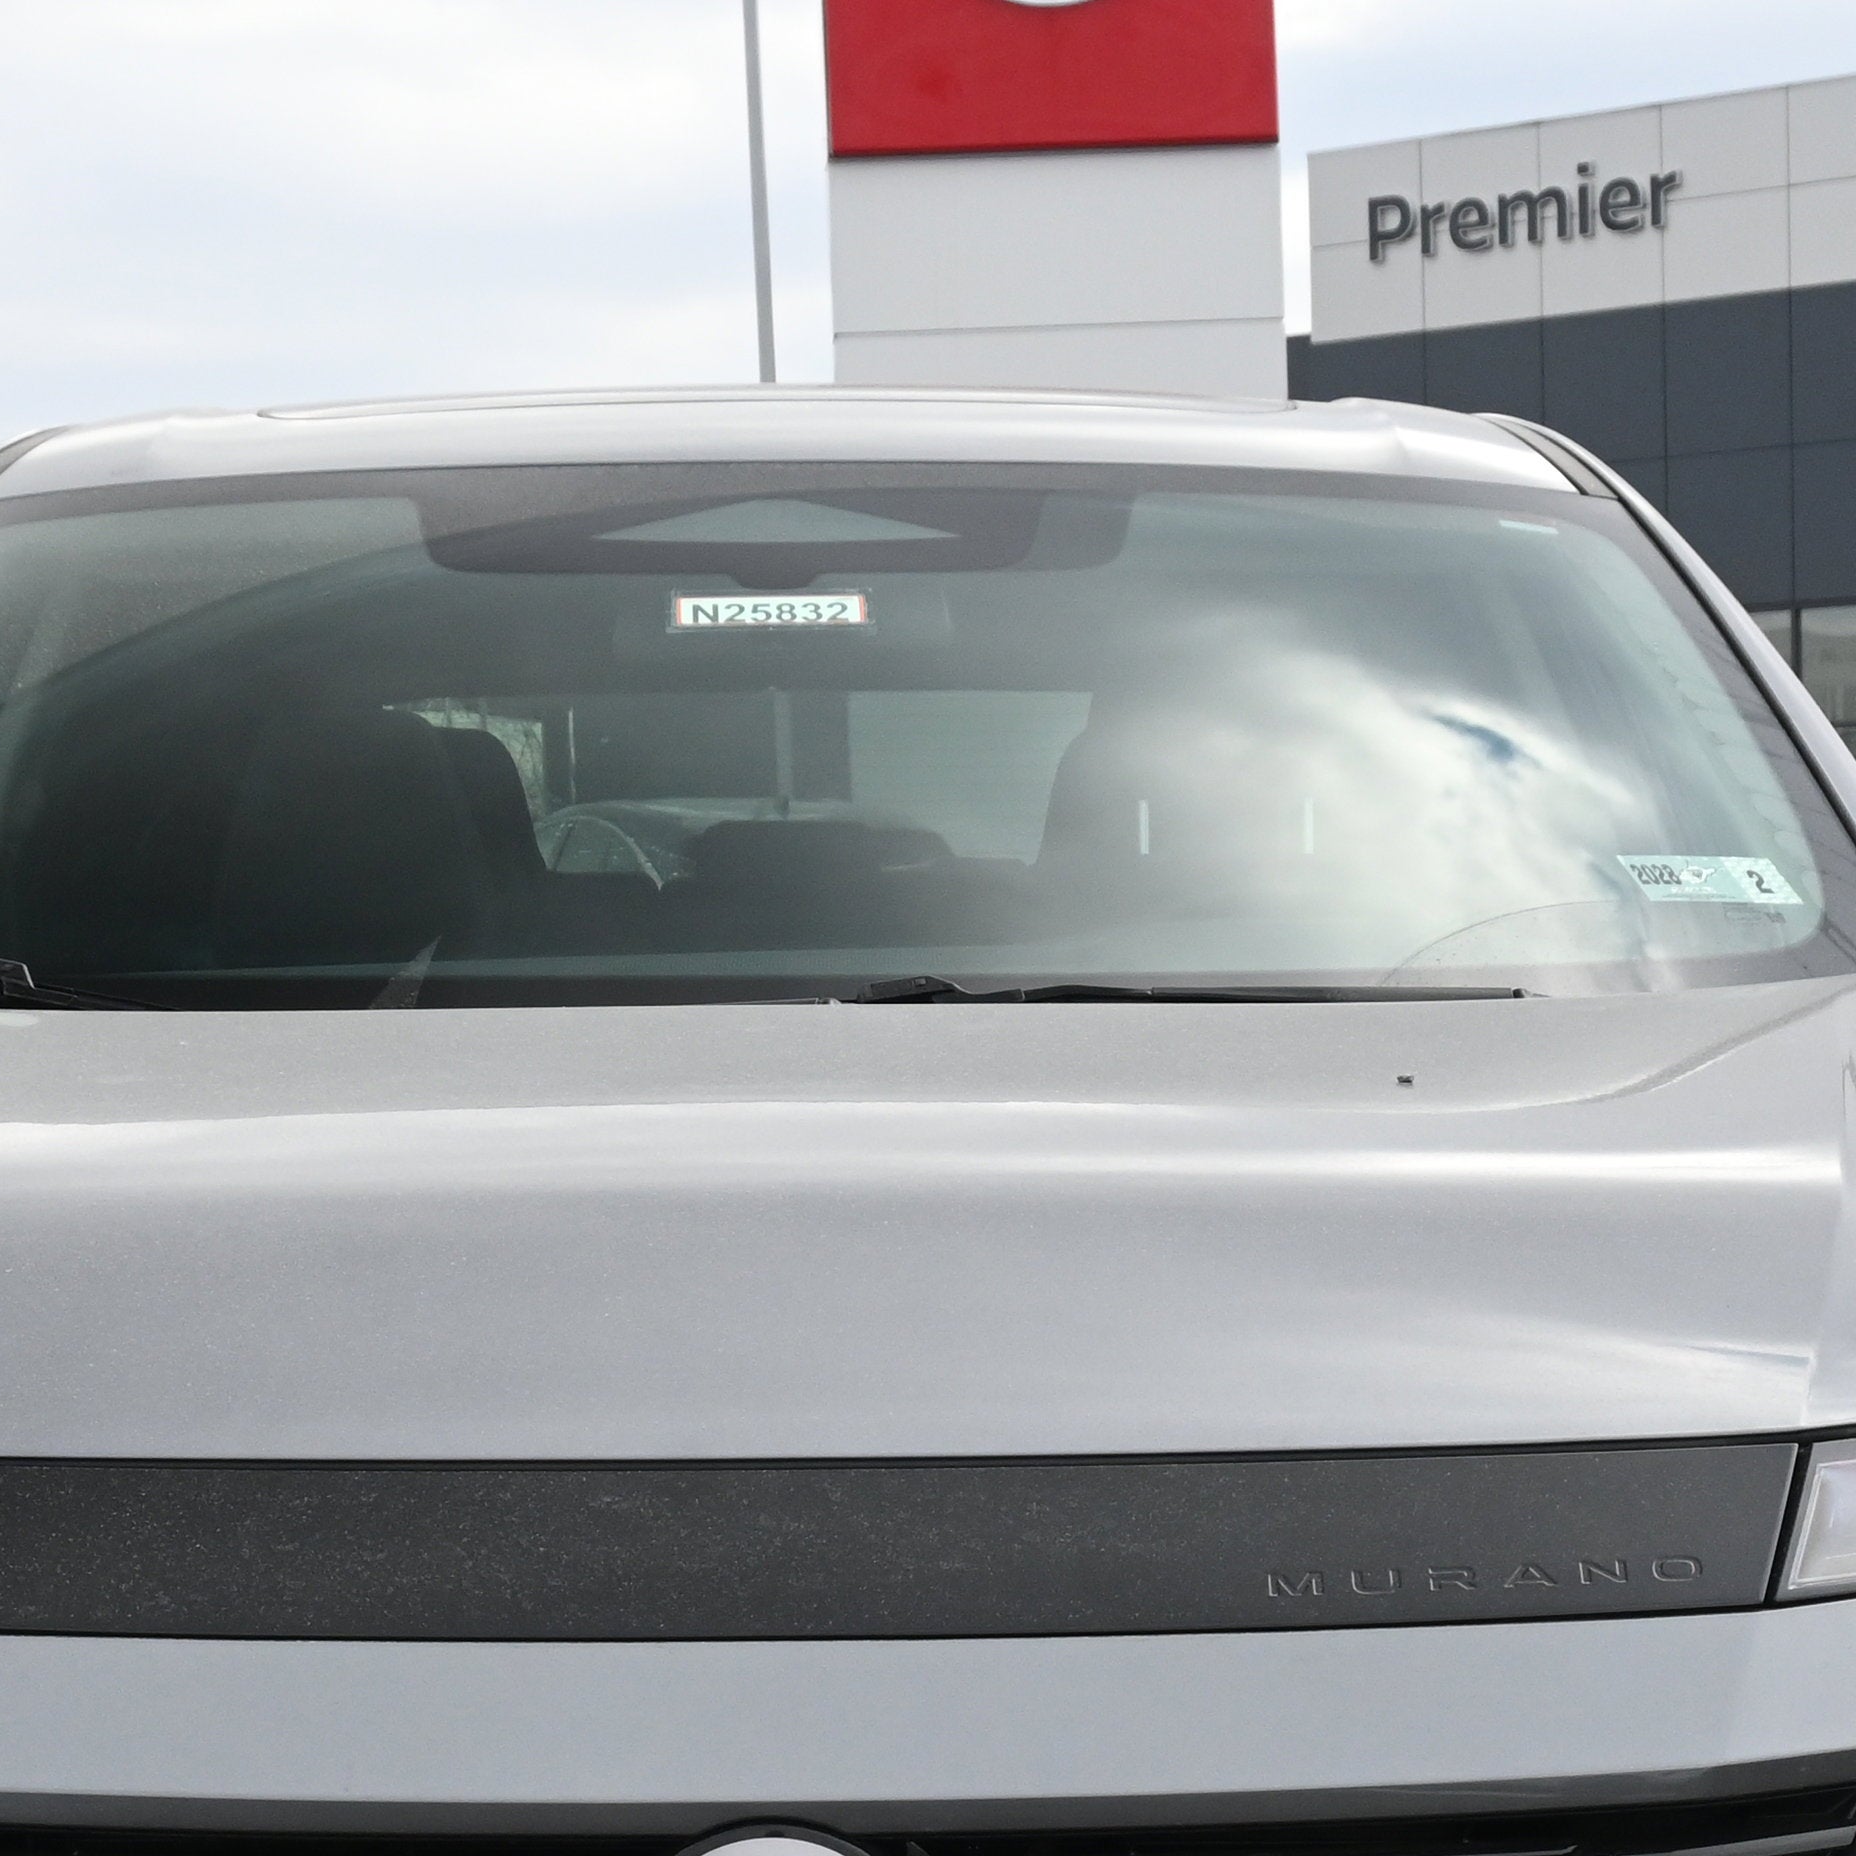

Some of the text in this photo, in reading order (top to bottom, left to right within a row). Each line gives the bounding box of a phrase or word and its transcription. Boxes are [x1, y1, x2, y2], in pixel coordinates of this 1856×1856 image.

[1368, 162, 1684, 263] Premier
[692, 602, 849, 623] N25832
[1747, 870, 1775, 894] 2
[1267, 1554, 1703, 1598] MURANO
